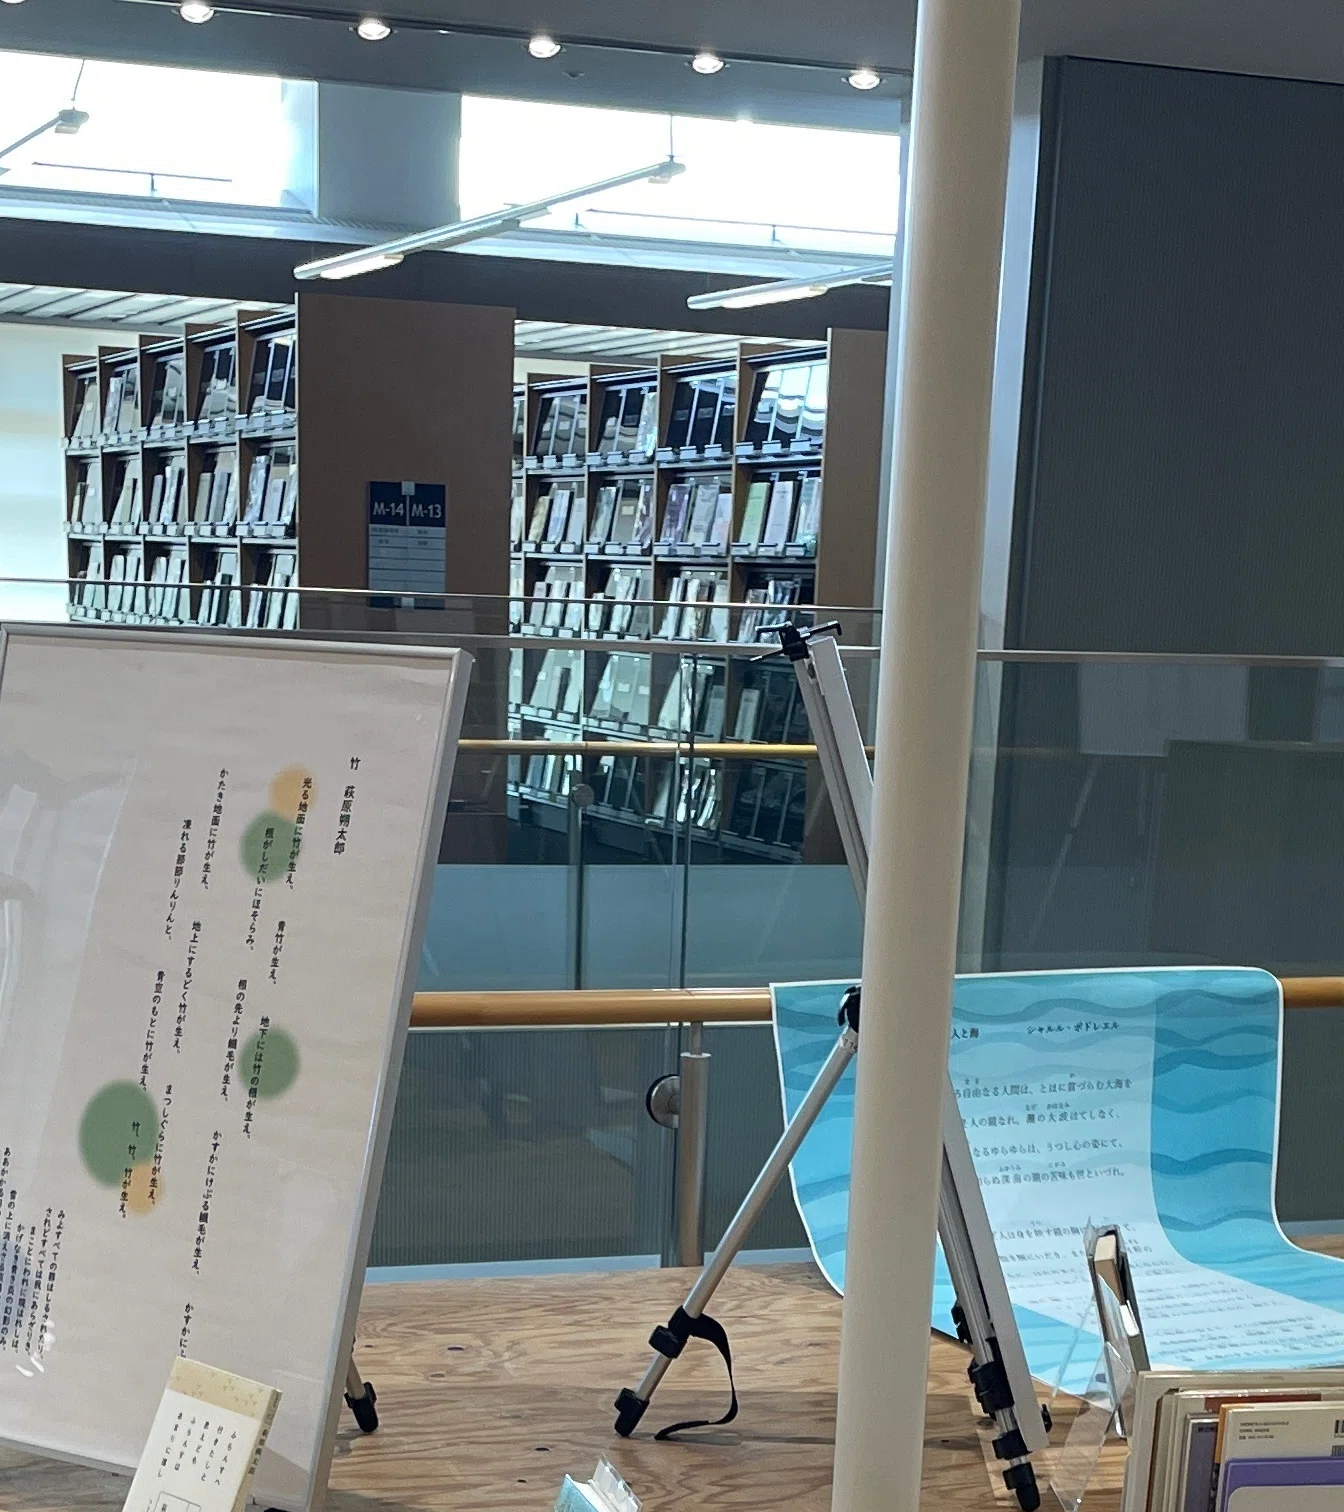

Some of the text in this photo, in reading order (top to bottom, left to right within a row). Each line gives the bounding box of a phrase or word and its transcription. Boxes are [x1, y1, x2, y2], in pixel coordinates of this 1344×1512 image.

[373, 502, 403, 516] M-14
[411, 504, 442, 518] M-13
[333, 757, 362, 856] 竹 萩原朔太郎
